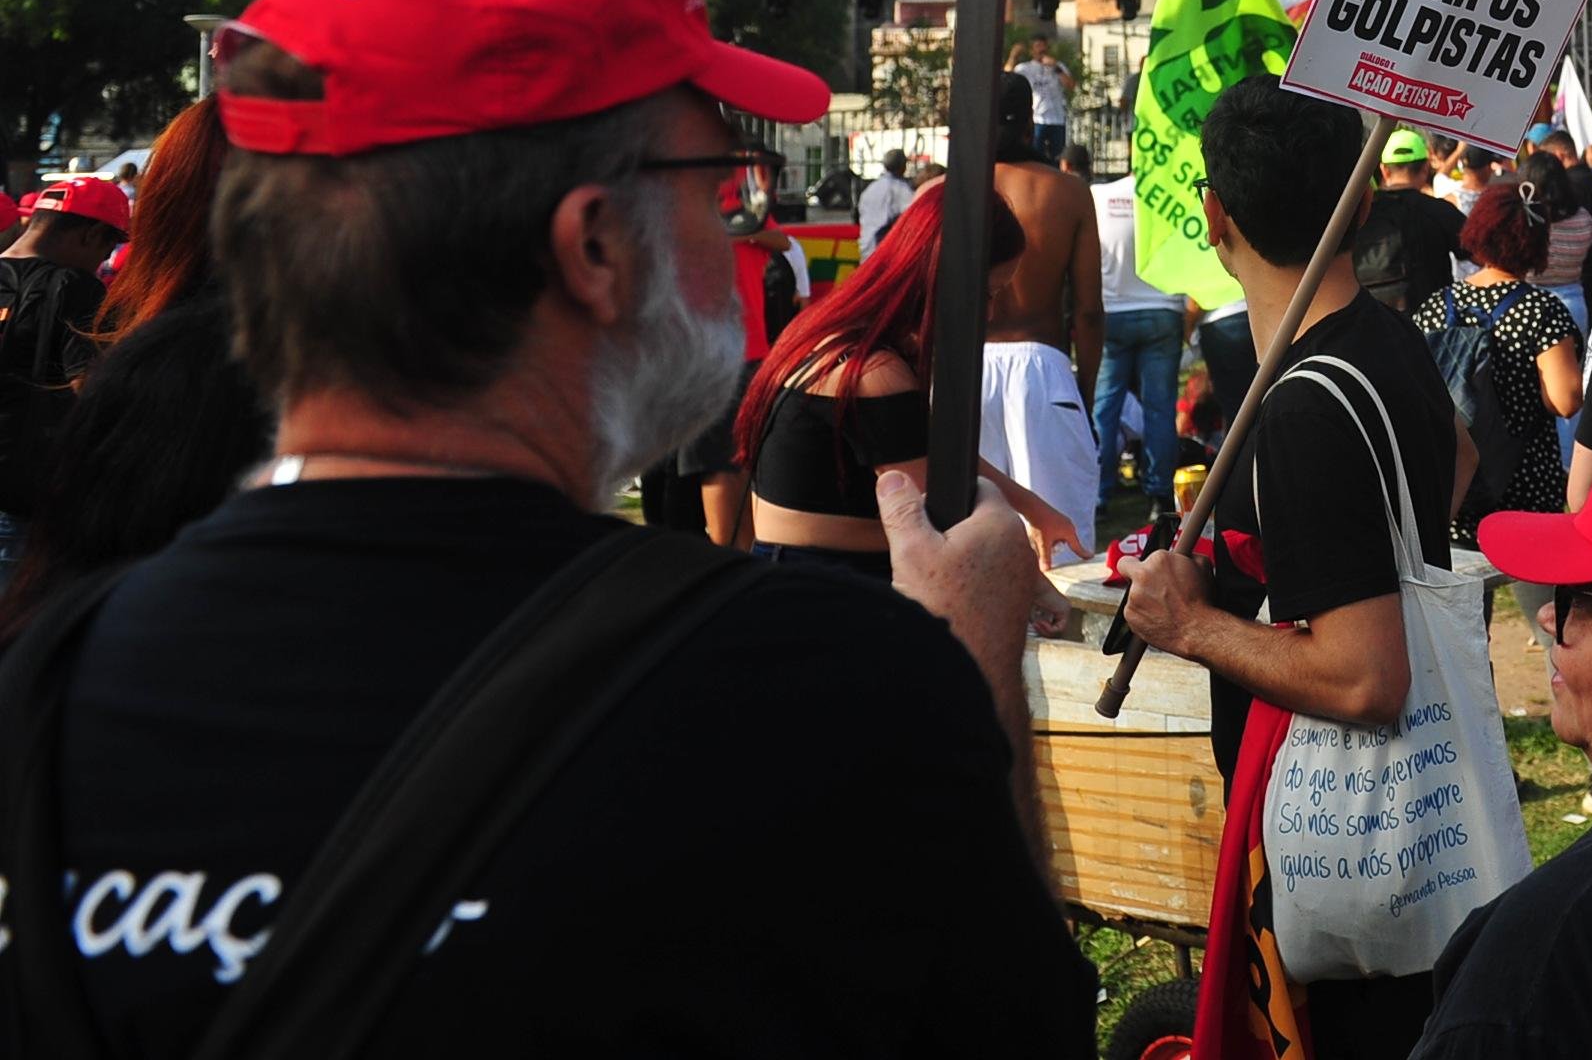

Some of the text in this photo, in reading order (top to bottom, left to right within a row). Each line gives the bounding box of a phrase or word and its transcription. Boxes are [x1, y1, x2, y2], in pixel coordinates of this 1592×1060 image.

[1360, 51, 1389, 68] DIÁLOGO
[1352, 69, 1469, 113] AÇÃO PETISTA PT
[1291, 727, 1339, 752] sempre
[1344, 729, 1352, 750] é
[1406, 703, 1452, 731] menos
[1285, 740, 1457, 806] do que nós queremos
[1279, 783, 1463, 837] Só nós somos sempre
[1280, 823, 1468, 892] iguais a nós próprios
[1437, 867, 1478, 889] Pessoa
